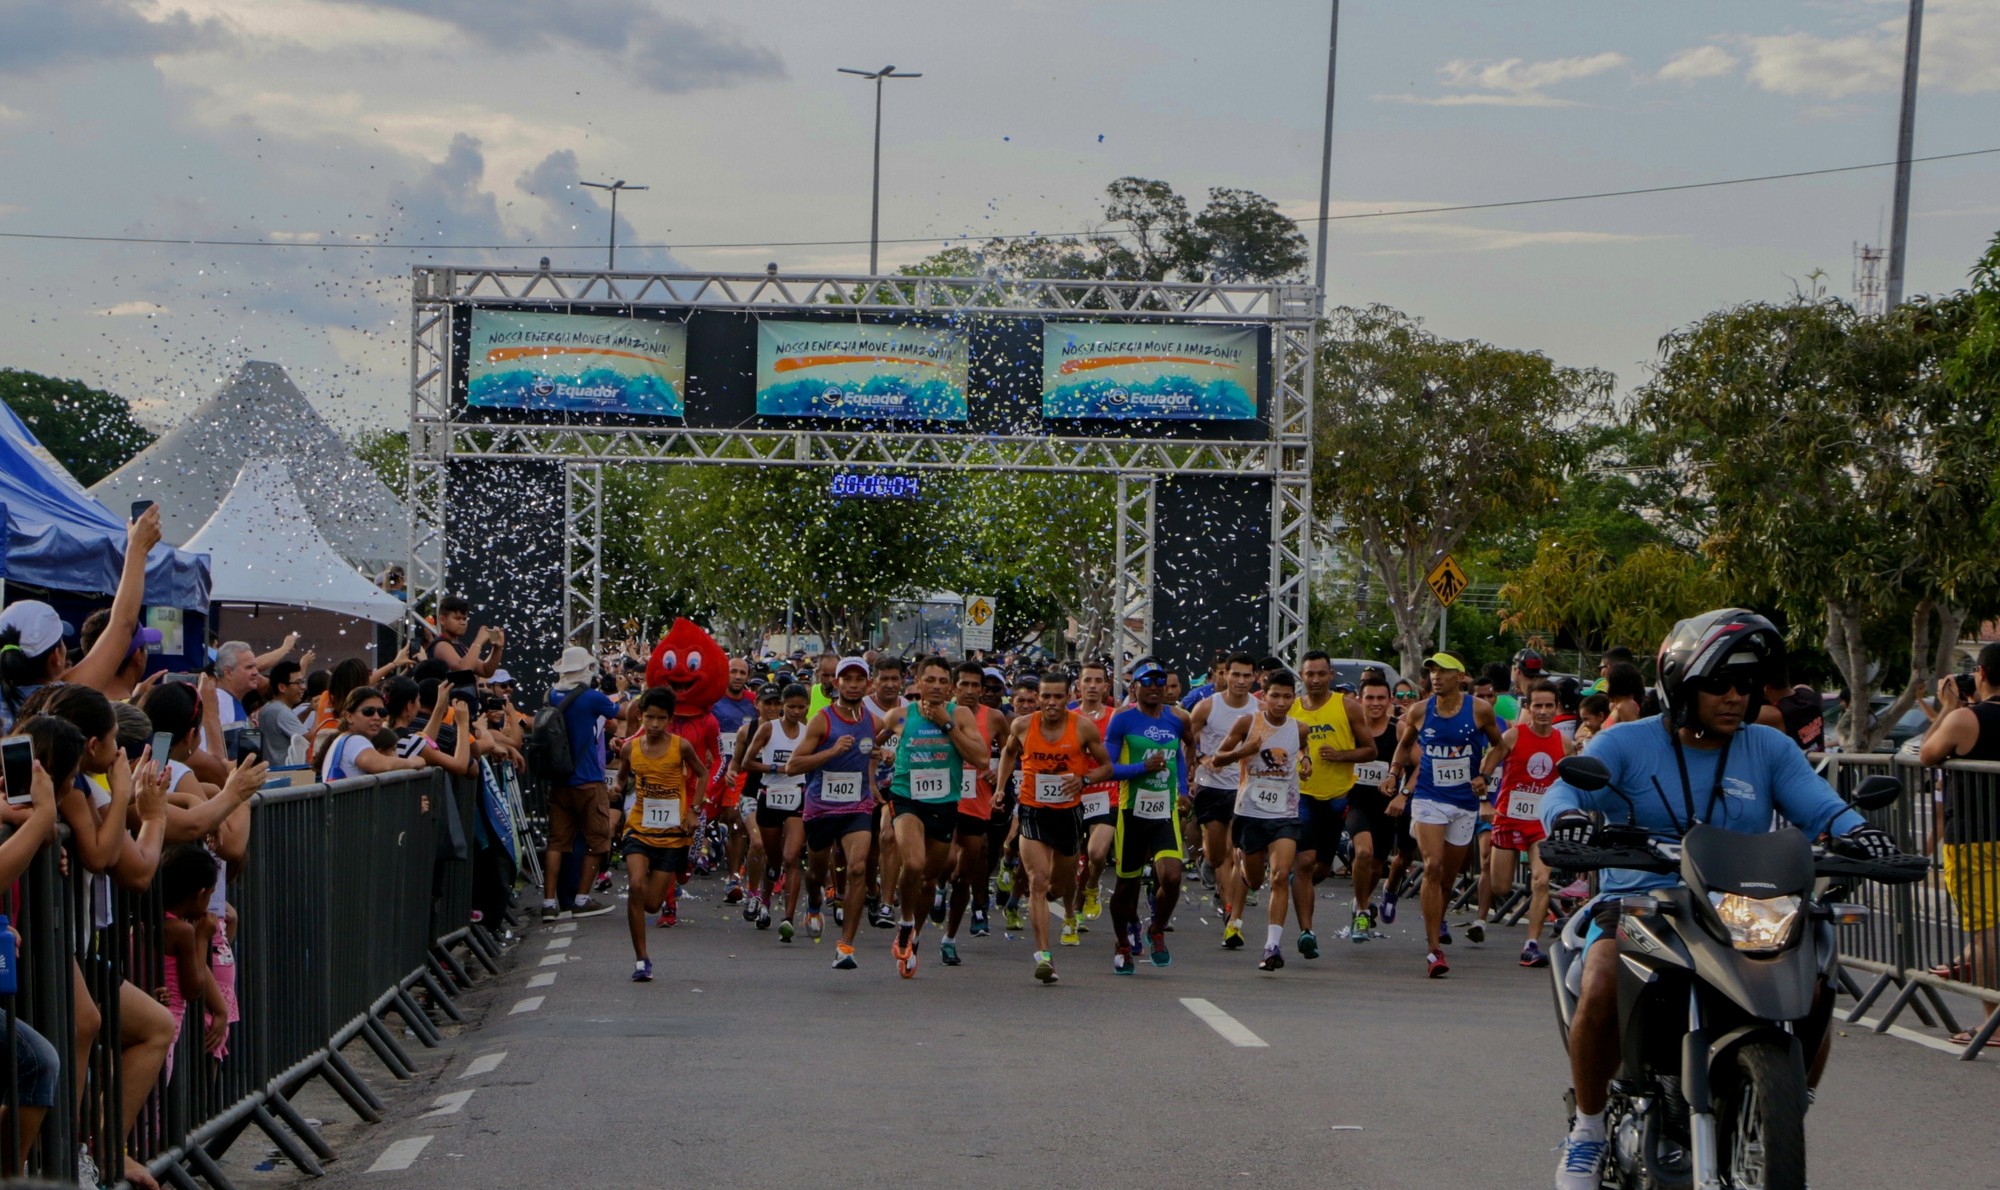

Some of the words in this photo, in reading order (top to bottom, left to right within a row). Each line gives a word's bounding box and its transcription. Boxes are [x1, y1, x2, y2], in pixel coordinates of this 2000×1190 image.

[488, 330, 523, 345] NOSSA
[525, 331, 571, 345] ENERGIA
[573, 332, 604, 346] MOVE
[775, 340, 810, 355] NOSSA
[812, 339, 857, 353] ENERGIA
[858, 339, 889, 354] MOVE
[1061, 341, 1095, 357] NOSSA
[1097, 340, 1142, 354] ENERGIA
[1144, 341, 1174, 353] MOVE
[556, 383, 620, 399] Equador
[844, 391, 907, 407] Equador
[1130, 392, 1193, 407] Equador
[833, 474, 918, 495] 00:00:04
[1425, 744, 1473, 757] CAIXA
[1357, 767, 1382, 781] 1194
[1437, 768, 1464, 781] 1413
[827, 782, 855, 795] 1402
[915, 779, 943, 792] 1013
[770, 793, 795, 805] 1217
[1258, 790, 1278, 804] 449
[1140, 800, 1165, 813] 1268
[1515, 801, 1534, 815] 401
[651, 809, 670, 822] 117
